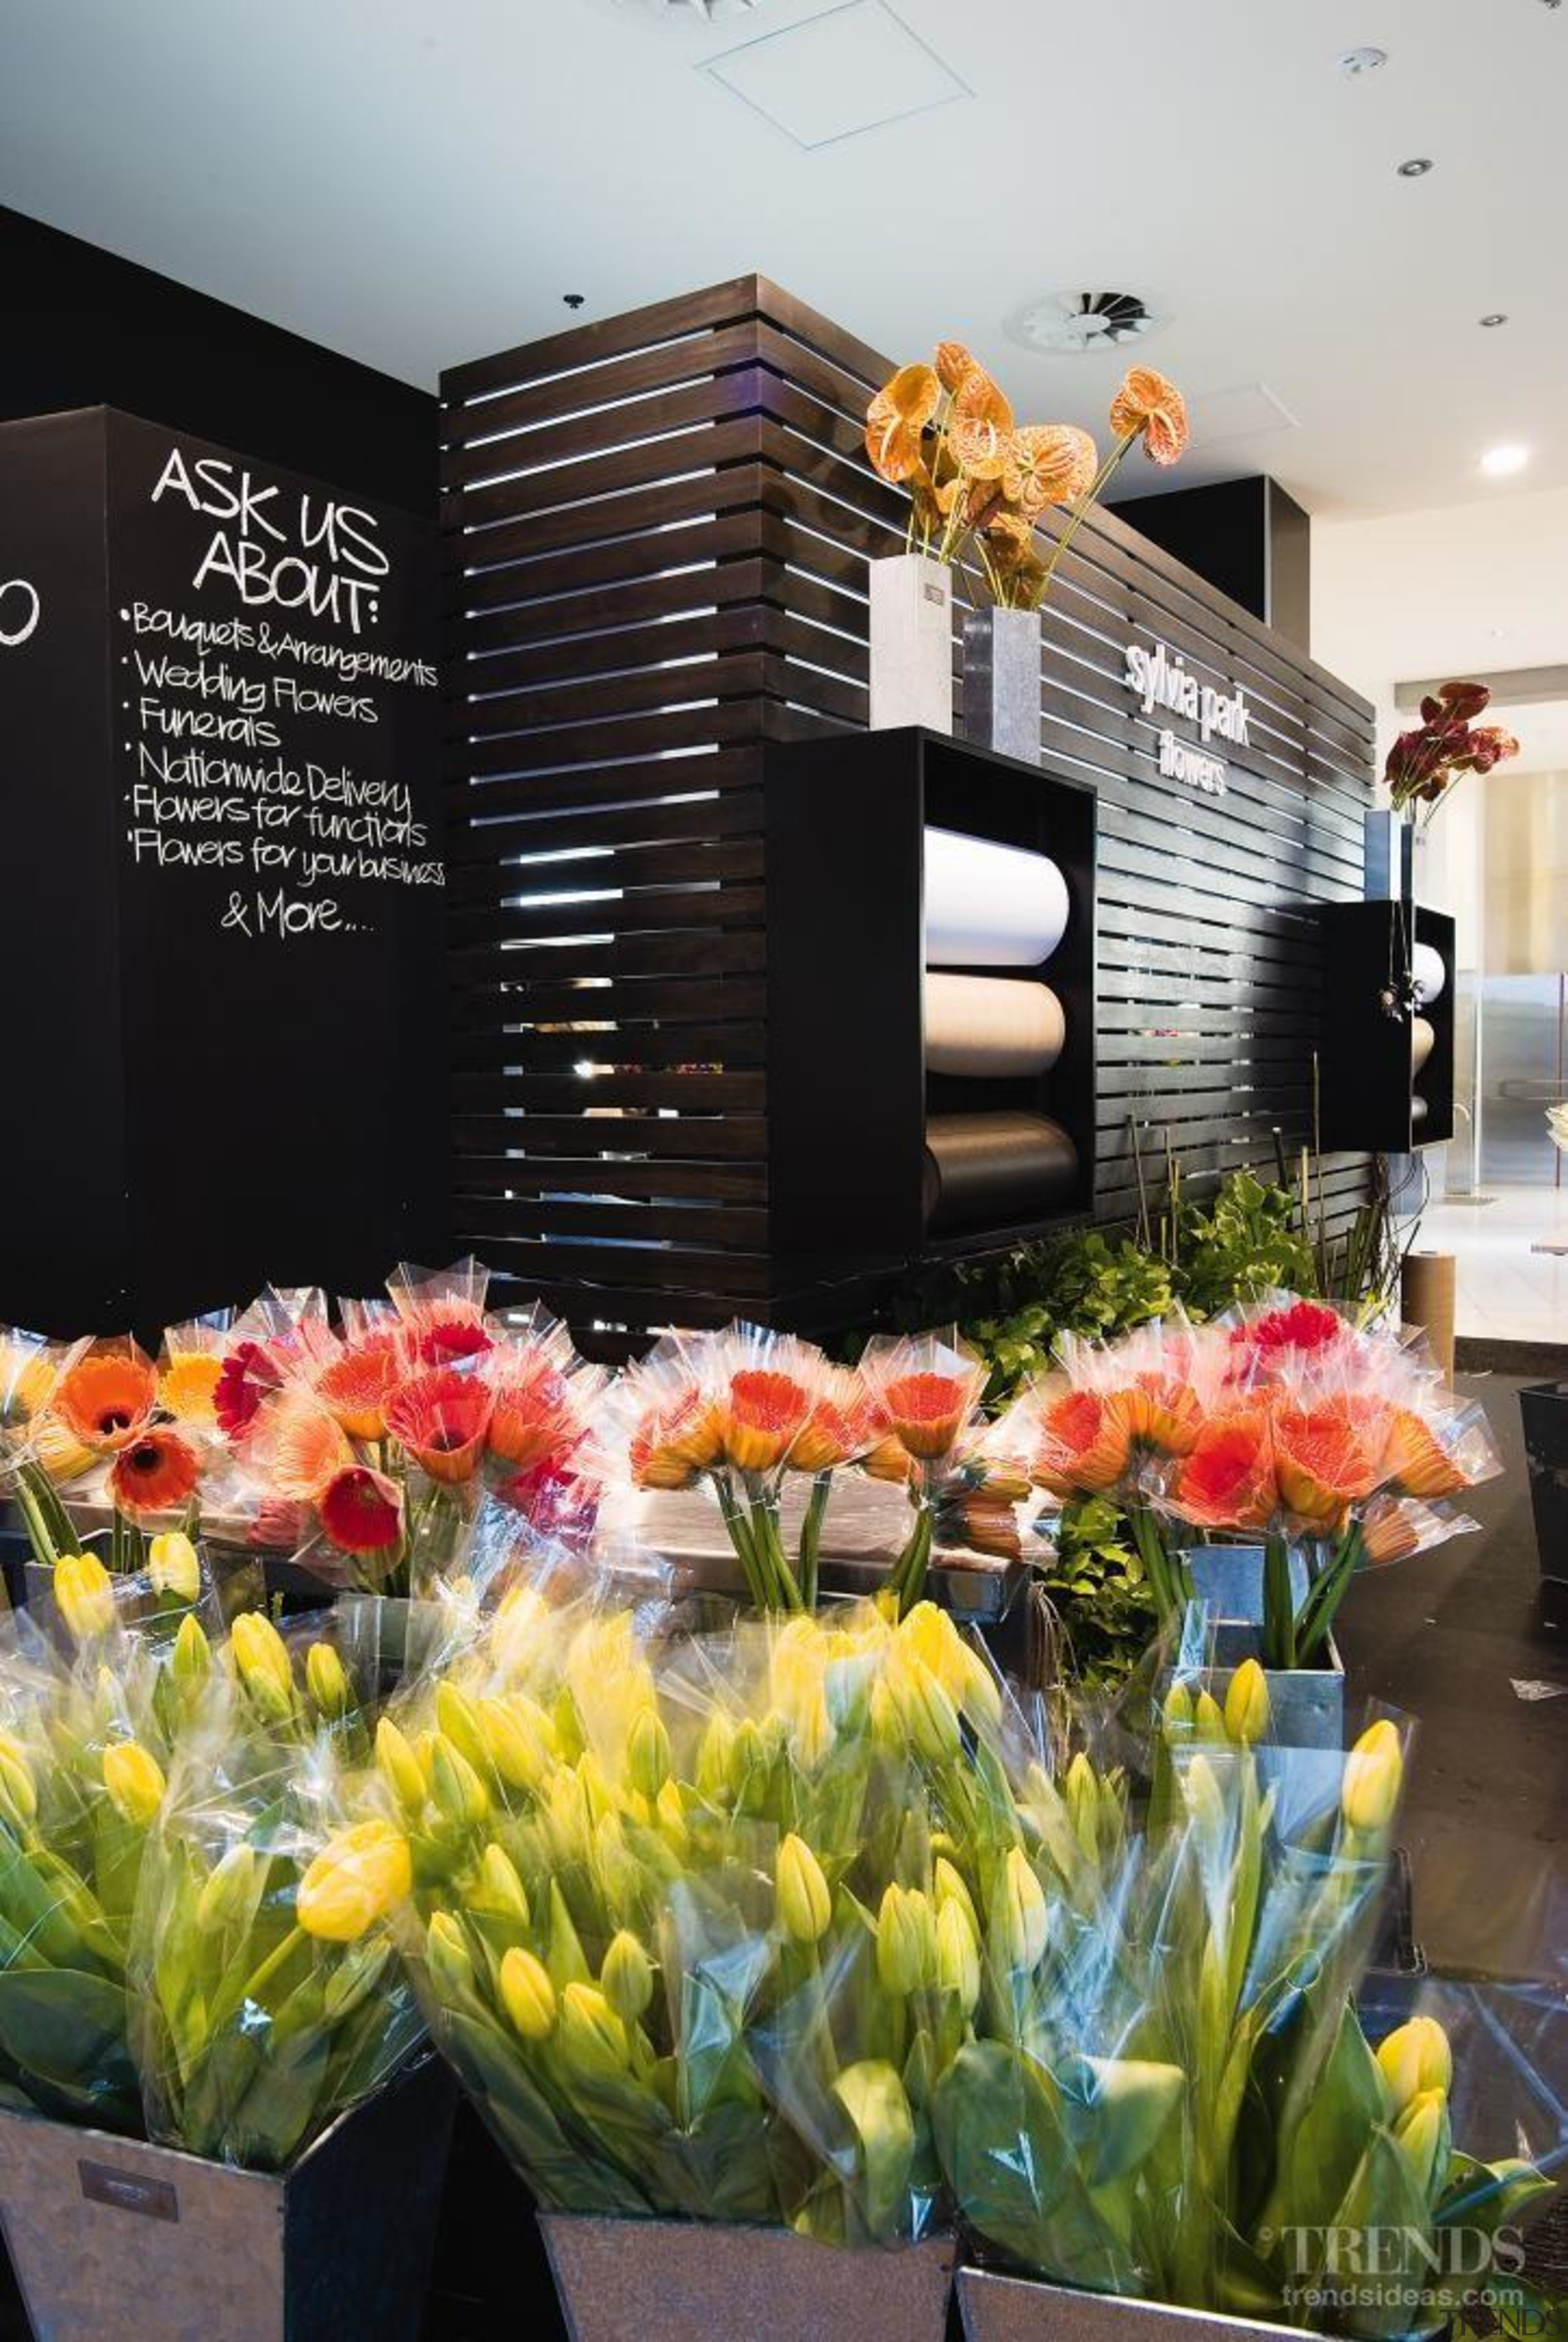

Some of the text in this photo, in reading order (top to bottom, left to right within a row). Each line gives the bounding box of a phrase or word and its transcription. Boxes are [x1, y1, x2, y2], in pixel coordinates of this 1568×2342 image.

[151, 448, 389, 574] ASK US
[192, 531, 379, 633] ABOUT:
[134, 602, 256, 655] Bouquets
[277, 633, 438, 686] Arrangements
[134, 649, 379, 723] Wedding Flowers
[140, 697, 281, 747] Funerals
[1125, 644, 1250, 747] sylvia park
[139, 742, 412, 819] Nationwide Delivery
[1159, 730, 1227, 796] flowers
[134, 785, 428, 848] Flowers for functions
[134, 828, 244, 866] Flowers
[251, 837, 297, 873] for
[221, 891, 252, 938] &
